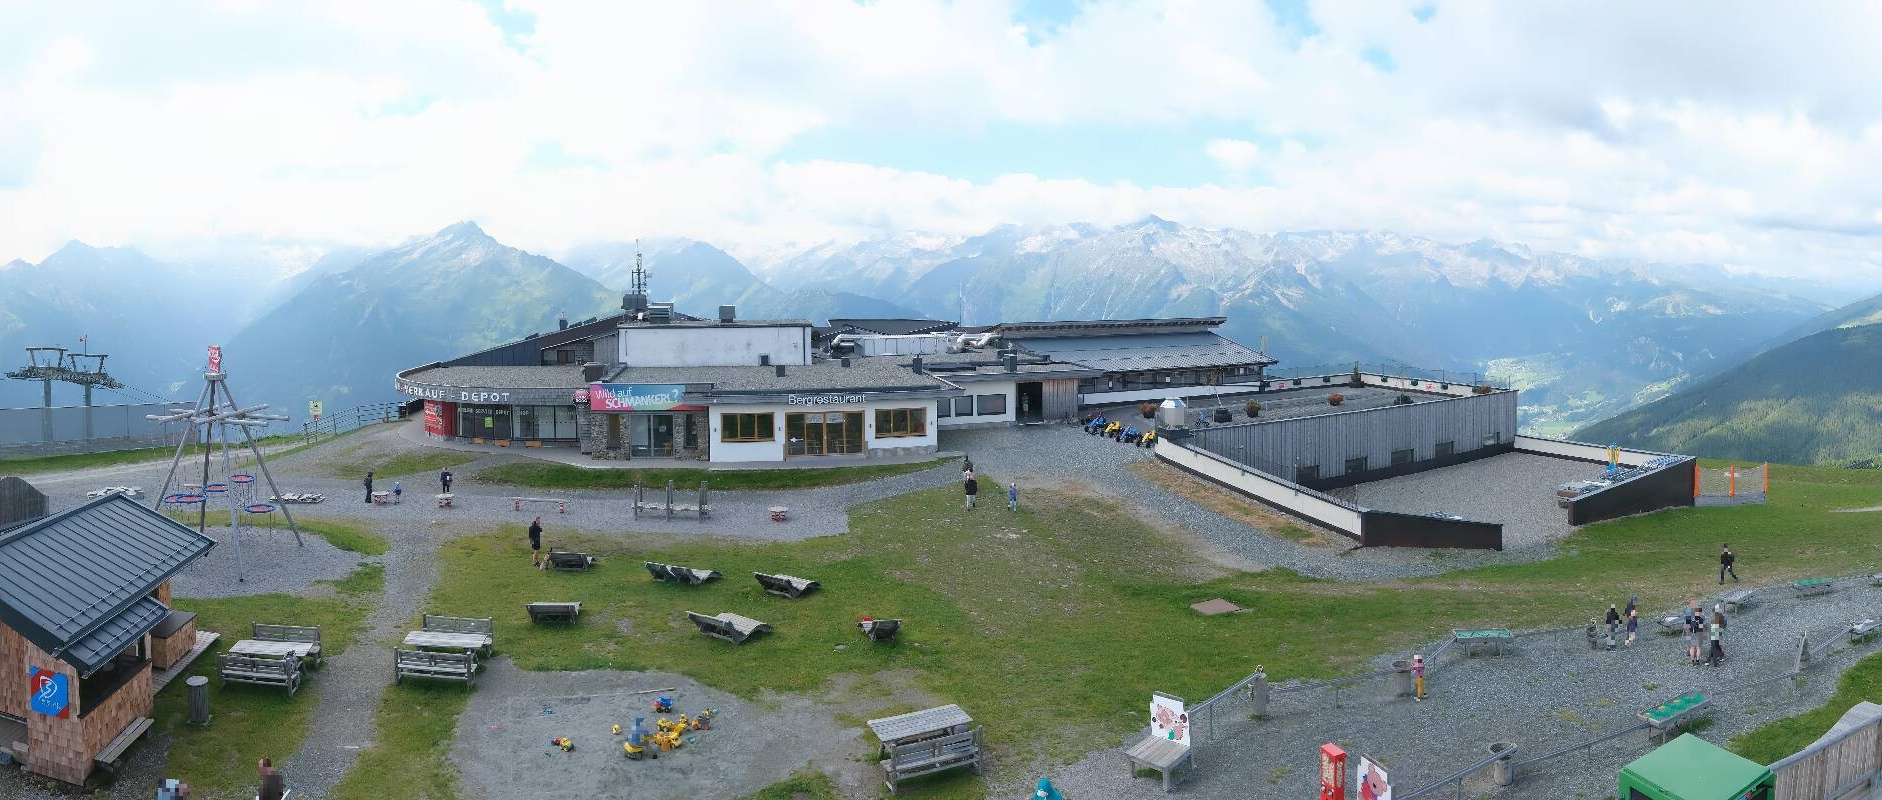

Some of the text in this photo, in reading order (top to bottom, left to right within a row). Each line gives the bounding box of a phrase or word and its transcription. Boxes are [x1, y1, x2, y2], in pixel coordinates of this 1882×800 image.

[404, 384, 446, 399] VERKAUF
[461, 391, 510, 402] DEPOT
[595, 389, 615, 400] Wild
[617, 386, 632, 398] auf
[788, 393, 866, 407] Bergrestaurant
